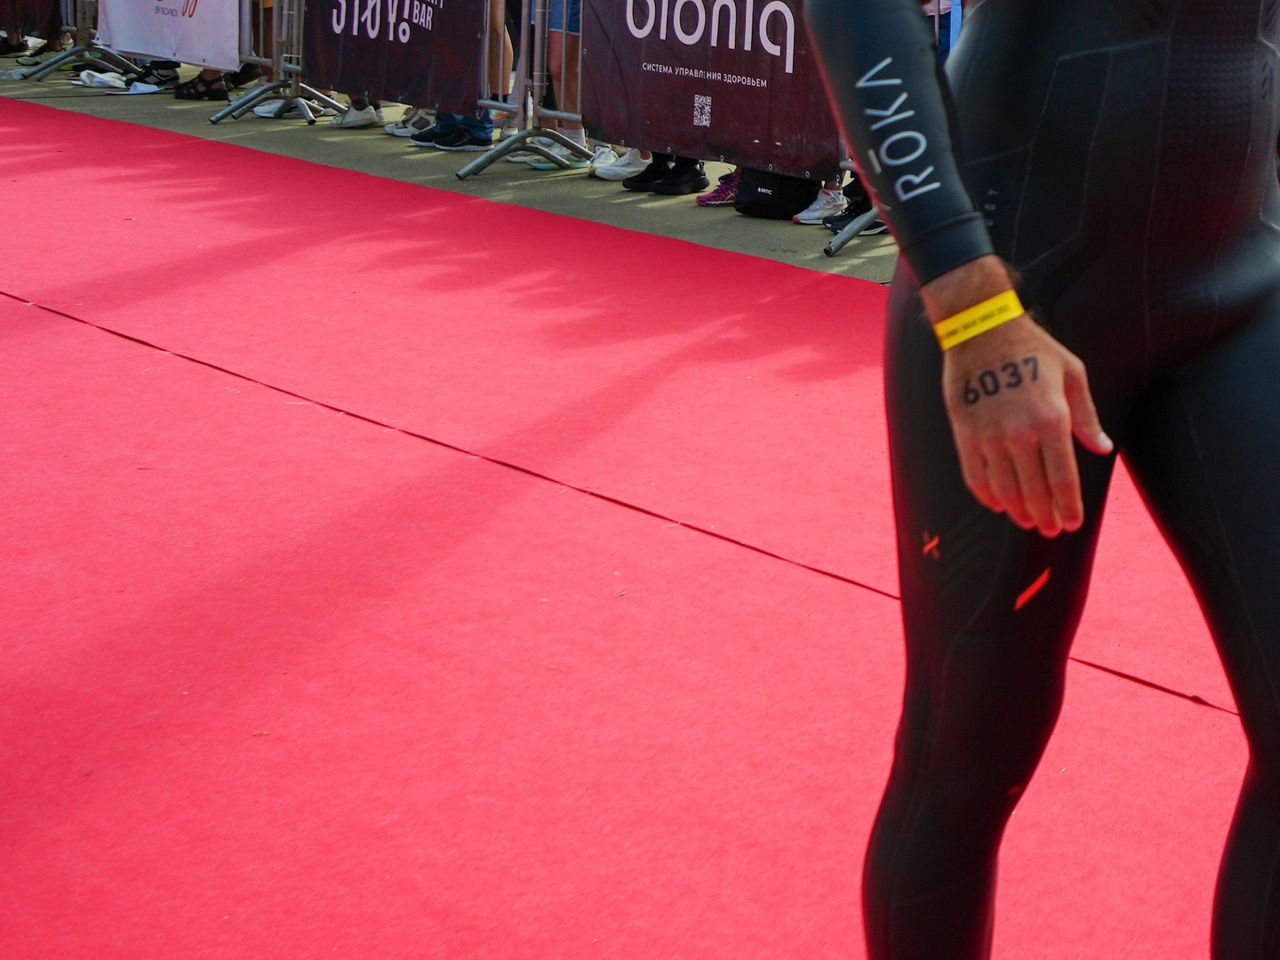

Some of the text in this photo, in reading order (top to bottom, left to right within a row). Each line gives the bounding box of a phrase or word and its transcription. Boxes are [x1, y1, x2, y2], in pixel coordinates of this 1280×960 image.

[412, 0, 433, 30] BAR
[642, 62, 673, 74] СИСТЕМА
[723, 73, 767, 88] ЗДОРОВЬЕМ
[962, 356, 1039, 405] 6037
